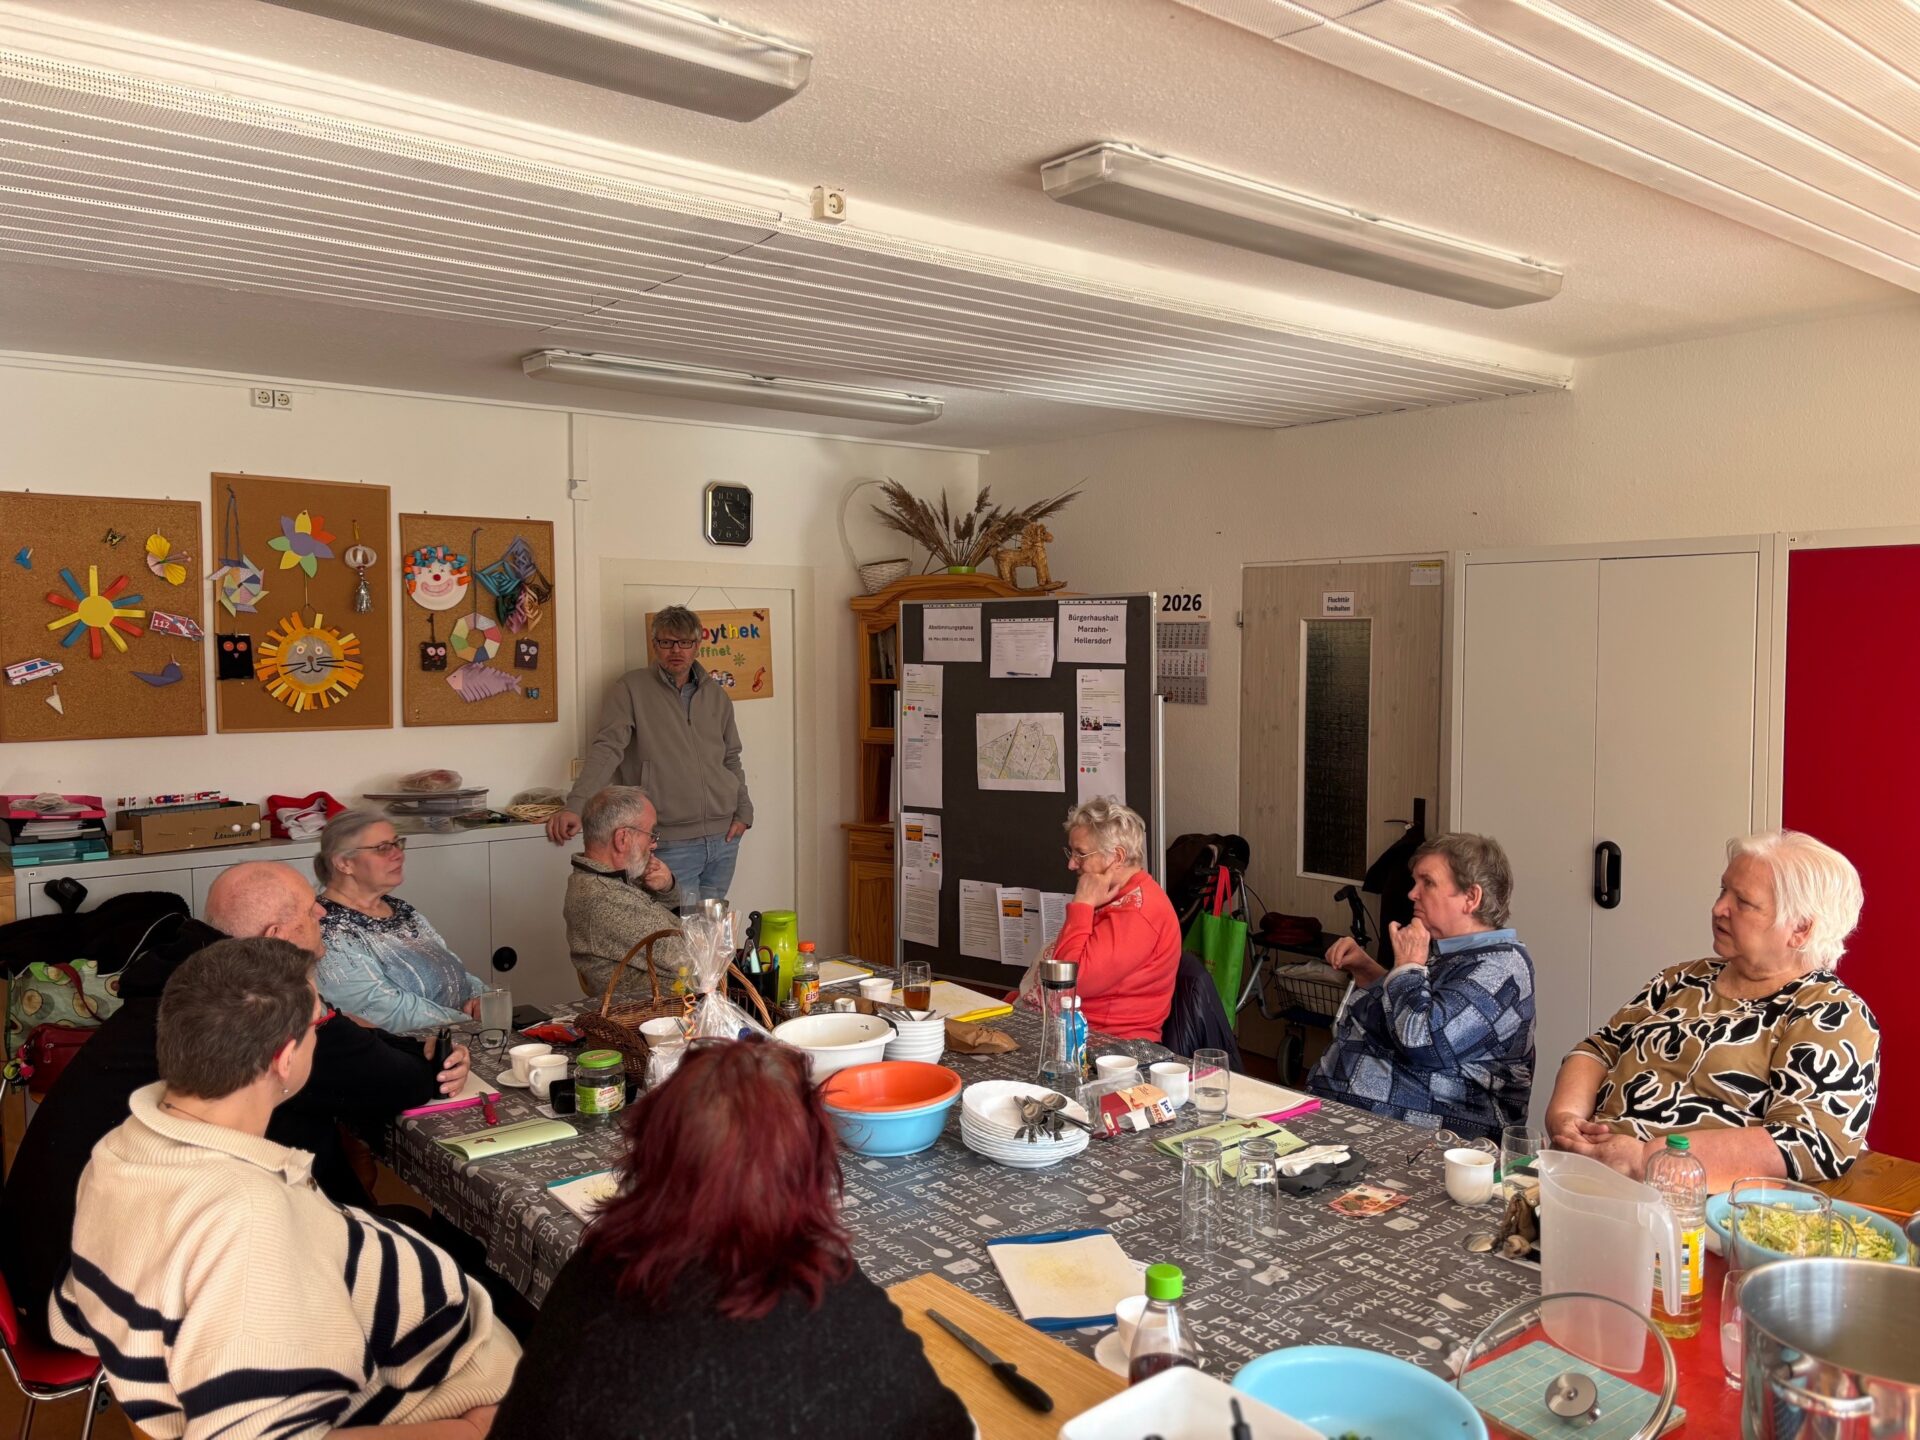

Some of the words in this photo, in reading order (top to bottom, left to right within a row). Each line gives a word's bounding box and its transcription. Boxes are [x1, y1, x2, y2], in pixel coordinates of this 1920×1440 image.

[1162, 594, 1202, 611] 2026
[154, 619, 170, 629] 112
[1068, 614, 1119, 622] Bürgerhaushalt
[1077, 625, 1109, 633] Marzahn-
[1074, 636, 1112, 645] Hellersdorf
[869, 1154, 949, 1183] breakfast
[1071, 1164, 1125, 1189] dining
[927, 1180, 979, 1205] petit
[926, 1210, 979, 1238] dining
[1275, 1220, 1358, 1252] breakfast
[1399, 1219, 1467, 1250] LUNCH
[1344, 1234, 1441, 1276] SUPPER
[1352, 1251, 1424, 1282] petit
[1264, 1271, 1343, 1304] LUNCH
[1464, 1280, 1502, 1298] &
[1203, 1292, 1303, 1341] SUPPER
[1375, 1289, 1452, 1323] dining
[1208, 1314, 1281, 1350] petit
